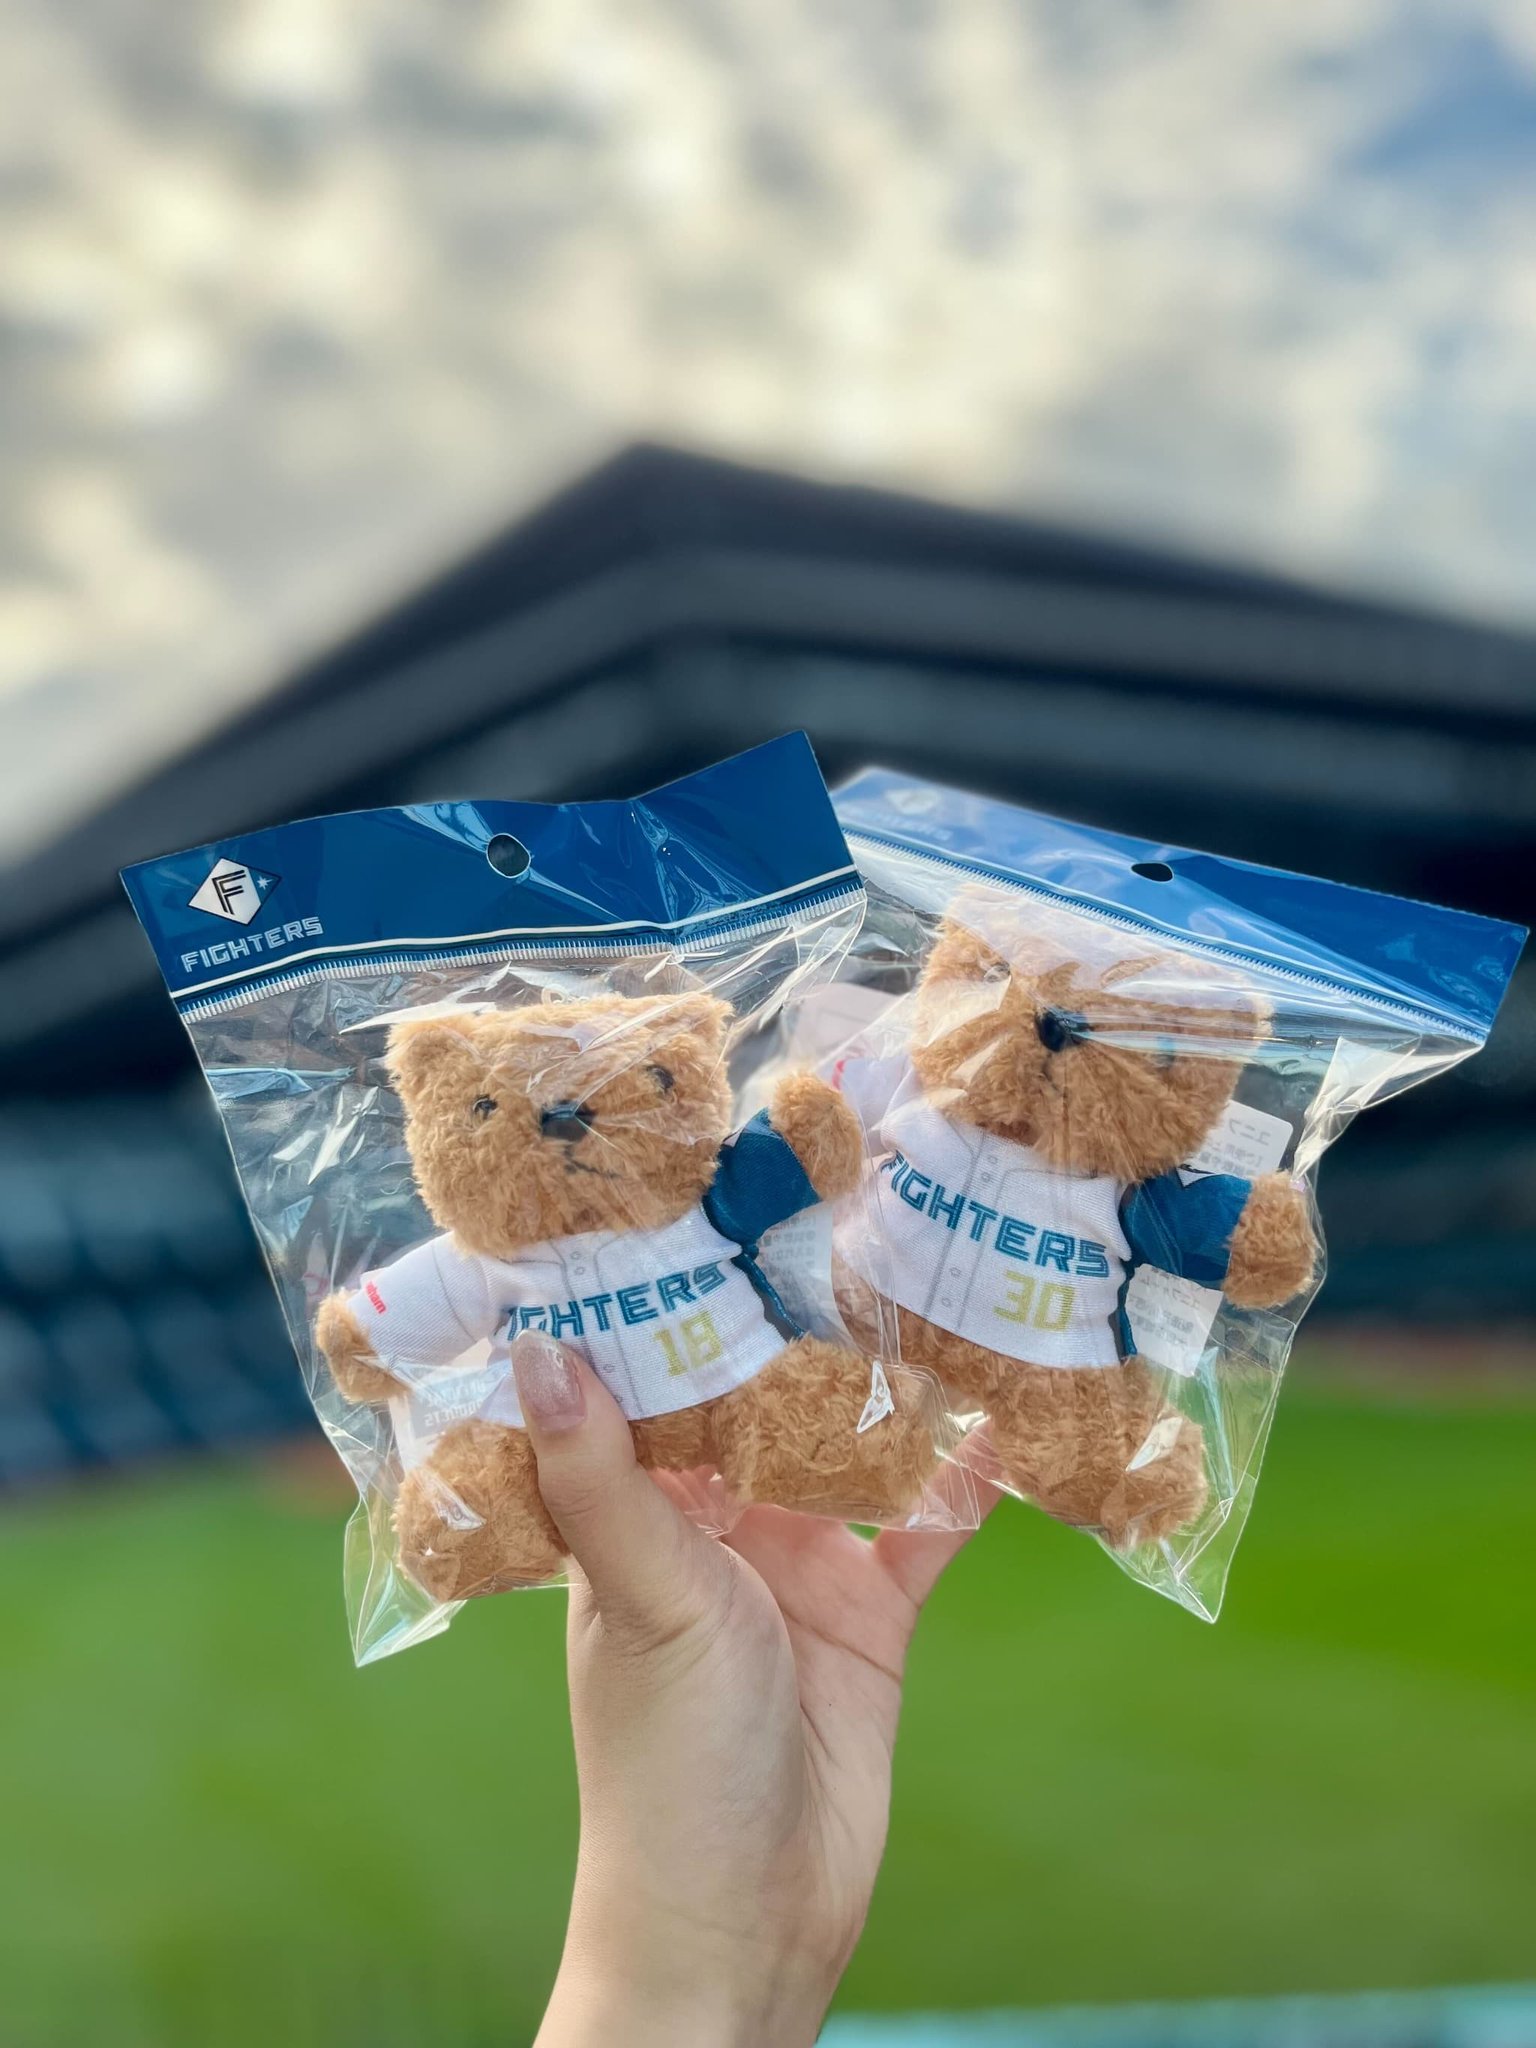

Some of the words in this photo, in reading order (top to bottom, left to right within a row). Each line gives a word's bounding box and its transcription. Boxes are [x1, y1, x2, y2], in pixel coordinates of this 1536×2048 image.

[211, 869, 247, 916] F
[180, 916, 324, 973] FIGHTERS
[503, 1261, 727, 1341] IGHTERS
[993, 1269, 1076, 1333] 30
[653, 1310, 723, 1378] 18
